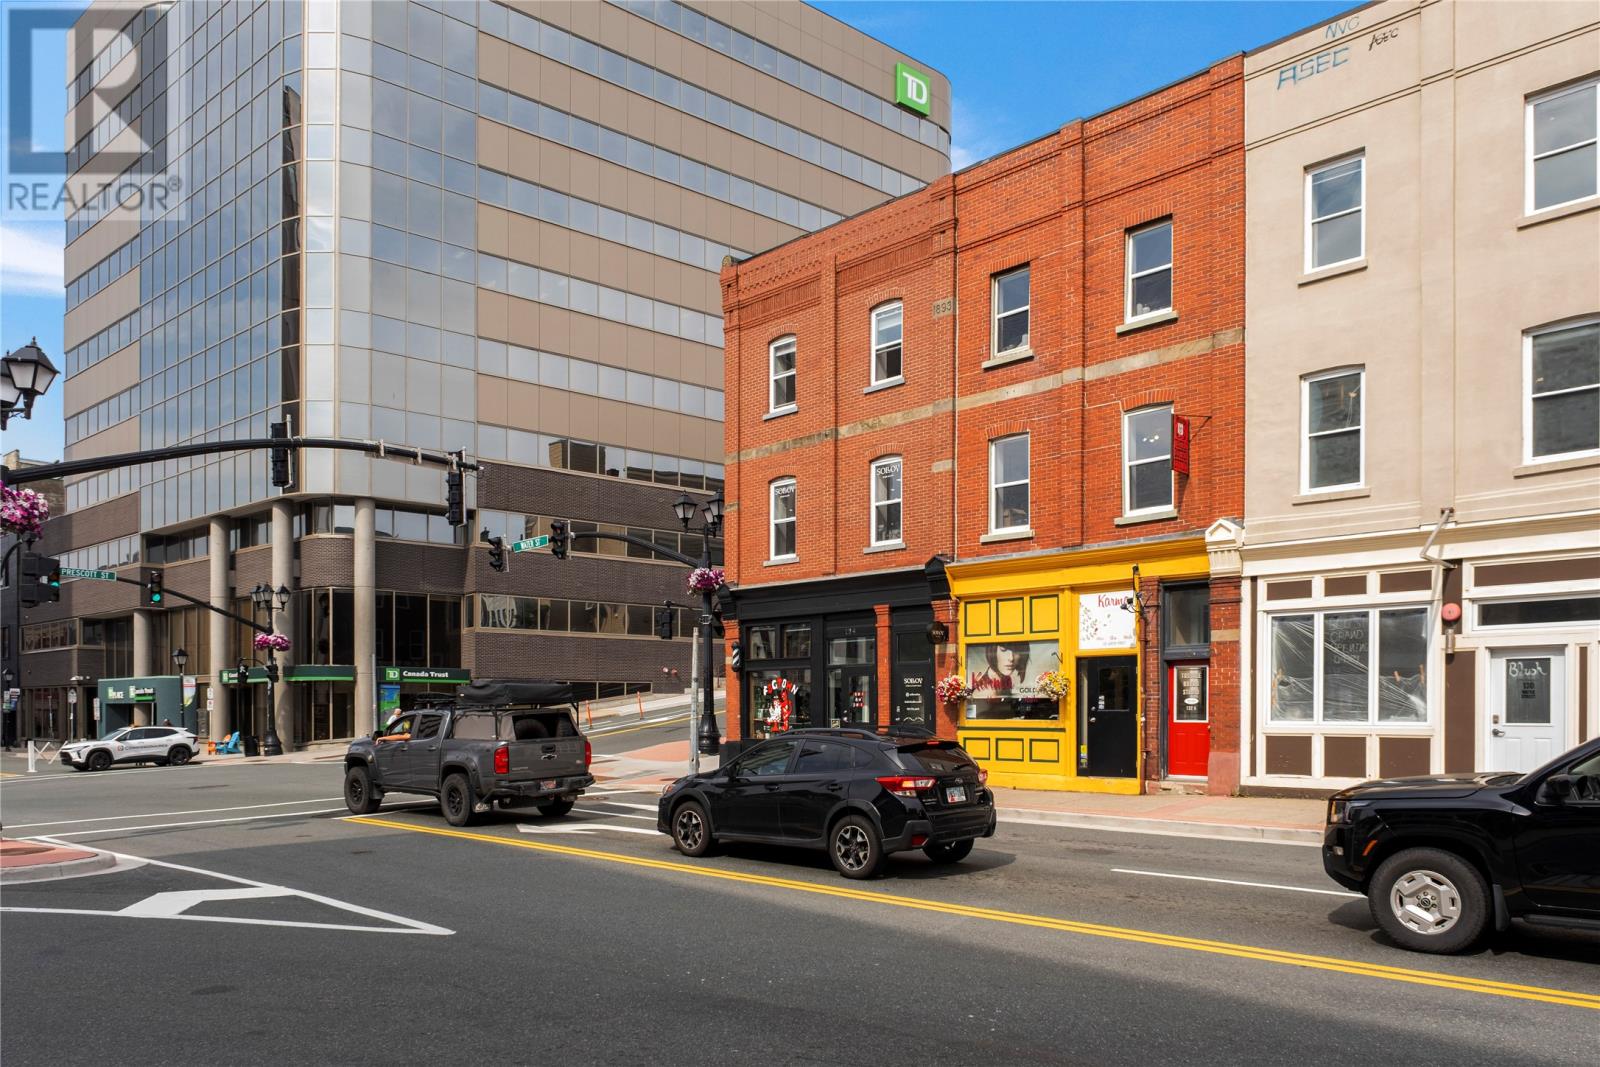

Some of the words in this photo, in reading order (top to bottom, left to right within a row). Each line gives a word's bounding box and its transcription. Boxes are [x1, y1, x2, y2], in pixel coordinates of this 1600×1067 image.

[902, 72, 927, 104] TD
[61, 568, 97, 578] PRESCOTT
[387, 670, 398, 678] TD
